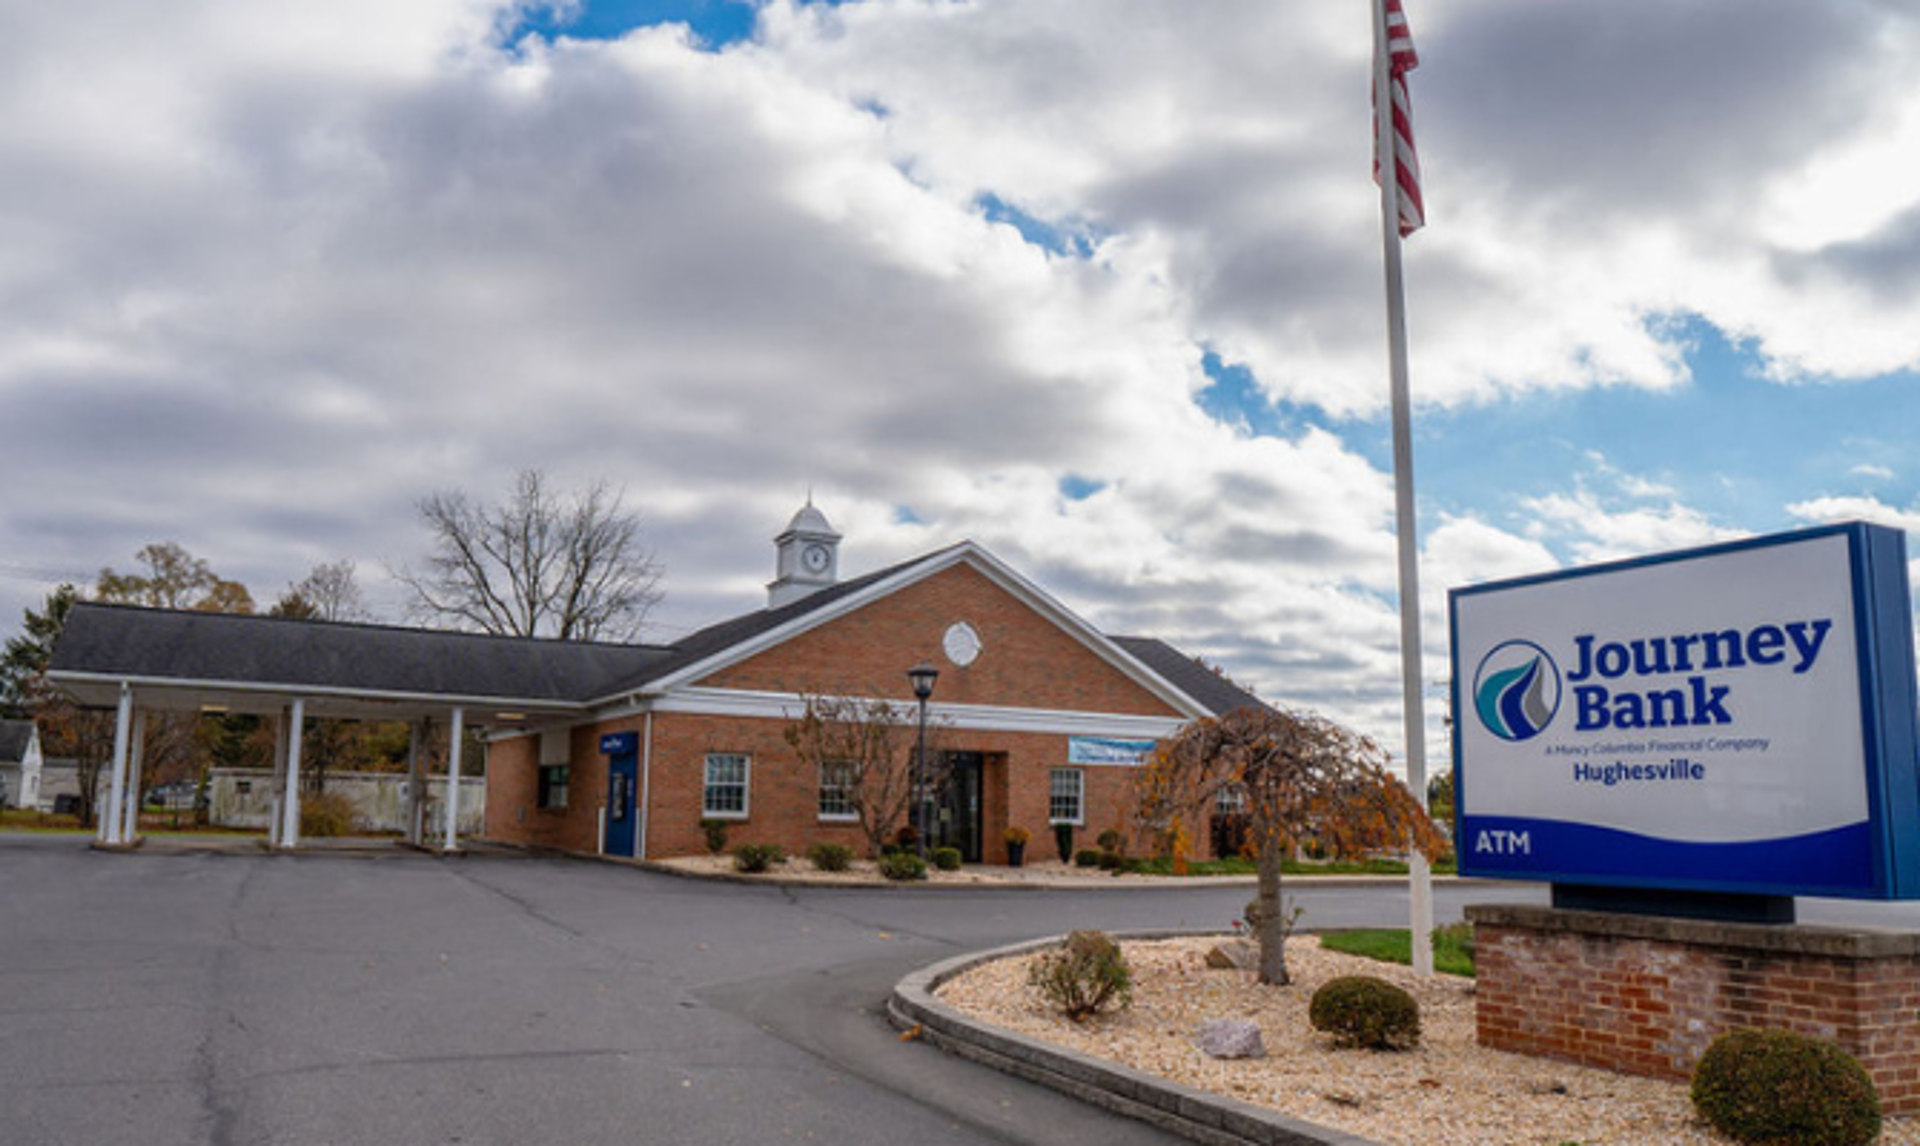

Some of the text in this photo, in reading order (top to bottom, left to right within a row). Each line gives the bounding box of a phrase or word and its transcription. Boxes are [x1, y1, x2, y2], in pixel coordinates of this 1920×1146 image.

[1567, 619, 1832, 681] Journey
[1573, 676, 1732, 731] Bank
[1545, 746, 1553, 755] A
[1593, 742, 1645, 755] Columbia
[1649, 740, 1702, 752] Financial
[1707, 738, 1769, 751] Company
[1574, 759, 1705, 786] Hughesville
[1475, 830, 1531, 854] ATM
